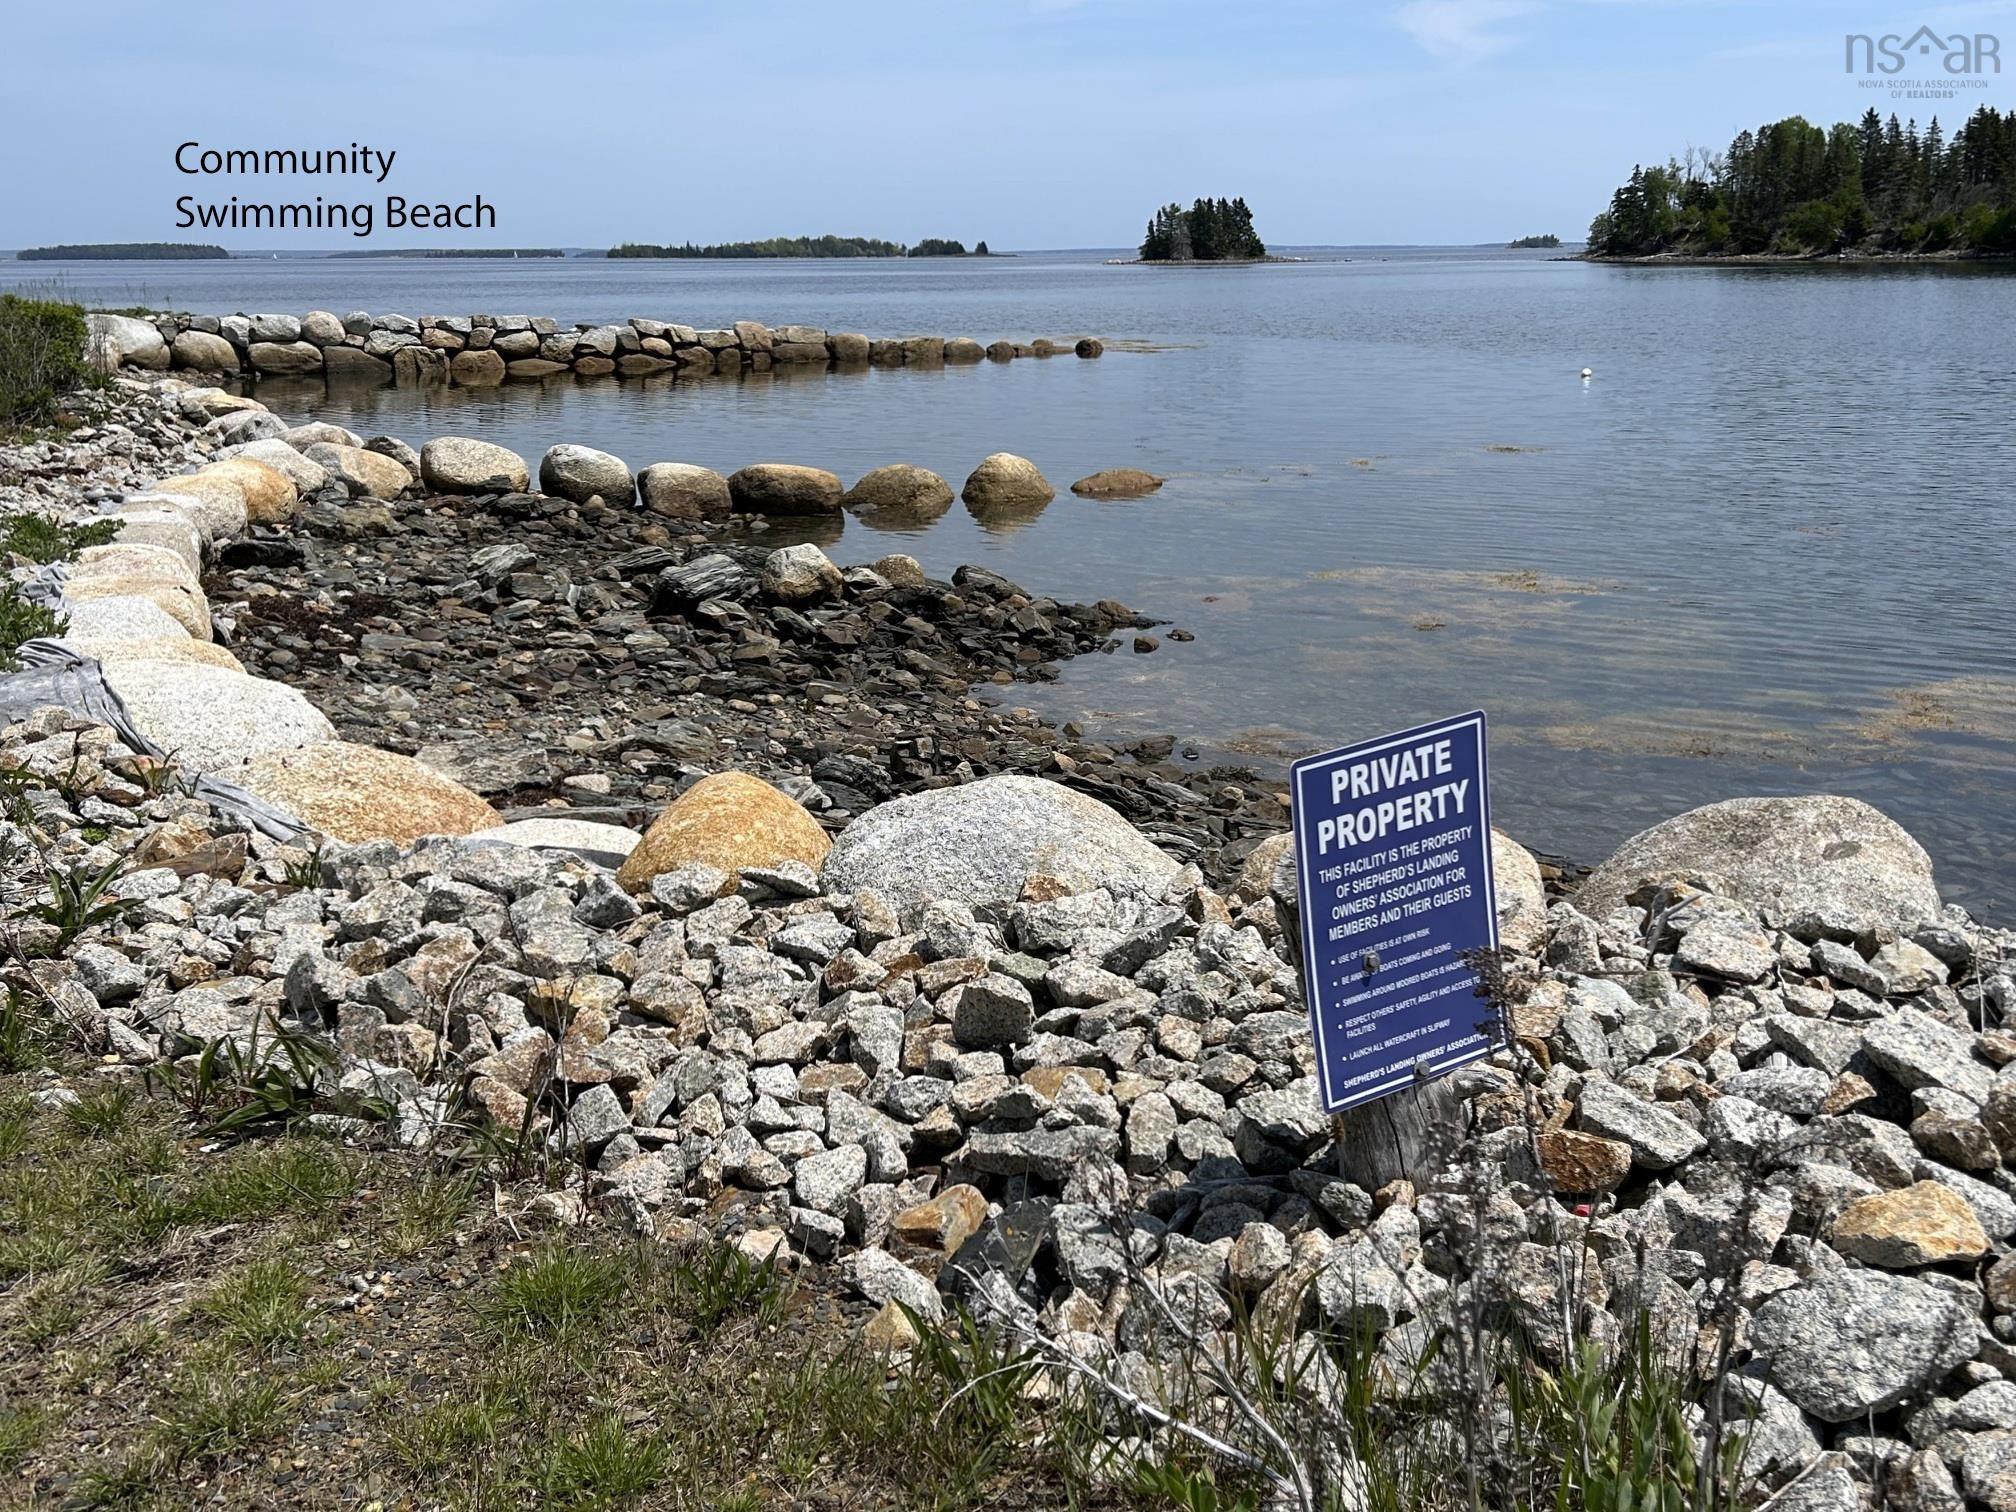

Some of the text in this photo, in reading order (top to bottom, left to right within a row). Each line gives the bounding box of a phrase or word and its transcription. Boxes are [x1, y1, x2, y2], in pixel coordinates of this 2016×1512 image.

[1331, 739, 1452, 805] PRIVATE
[1317, 779, 1469, 855] PROPERTY
[1319, 825, 1473, 883] THIS FACILITY IS THE PROPERTY
[1336, 850, 1459, 899] OF SHEPHERD'S LANDING
[1328, 884, 1472, 942] MEMBERS AND THEIR GUESTS
[1332, 867, 1466, 920] OWNERS' ASSOCIATION FOR
[1338, 953, 1350, 964] USE
[1350, 950, 1358, 960] OF
[1388, 938, 1395, 948] IS
[1395, 936, 1402, 945] AT
[1402, 932, 1416, 943] OWN
[1416, 927, 1431, 938] RISK
[1341, 975, 1350, 985] BE
[1379, 959, 1398, 973] BOATS
[1398, 952, 1421, 966] COMING
[1421, 948, 1434, 958] AND
[1433, 942, 1452, 955] GOING
[1342, 990, 1372, 1007] SWIMMING
[1372, 982, 1396, 997] AROUND
[1395, 974, 1420, 989] MOORED
[1420, 968, 1439, 981] BOATS
[1439, 966, 1445, 974] IS
[1345, 1012, 1371, 1028] RESPECT
[1418, 990, 1439, 1004] AGILITY
[1439, 985, 1451, 996] AND
[1451, 978, 1473, 992] ACCESS
[1472, 975, 1481, 985] TO
[1346, 1022, 1377, 1039] FACILITIES
[1349, 1018, 1451, 1060] LAUNCH ALL WATERCRAFT IN SLIPWAY
[1343, 1067, 1386, 1089] SHEPHERD'S
[1385, 1056, 1416, 1074] LANDING
